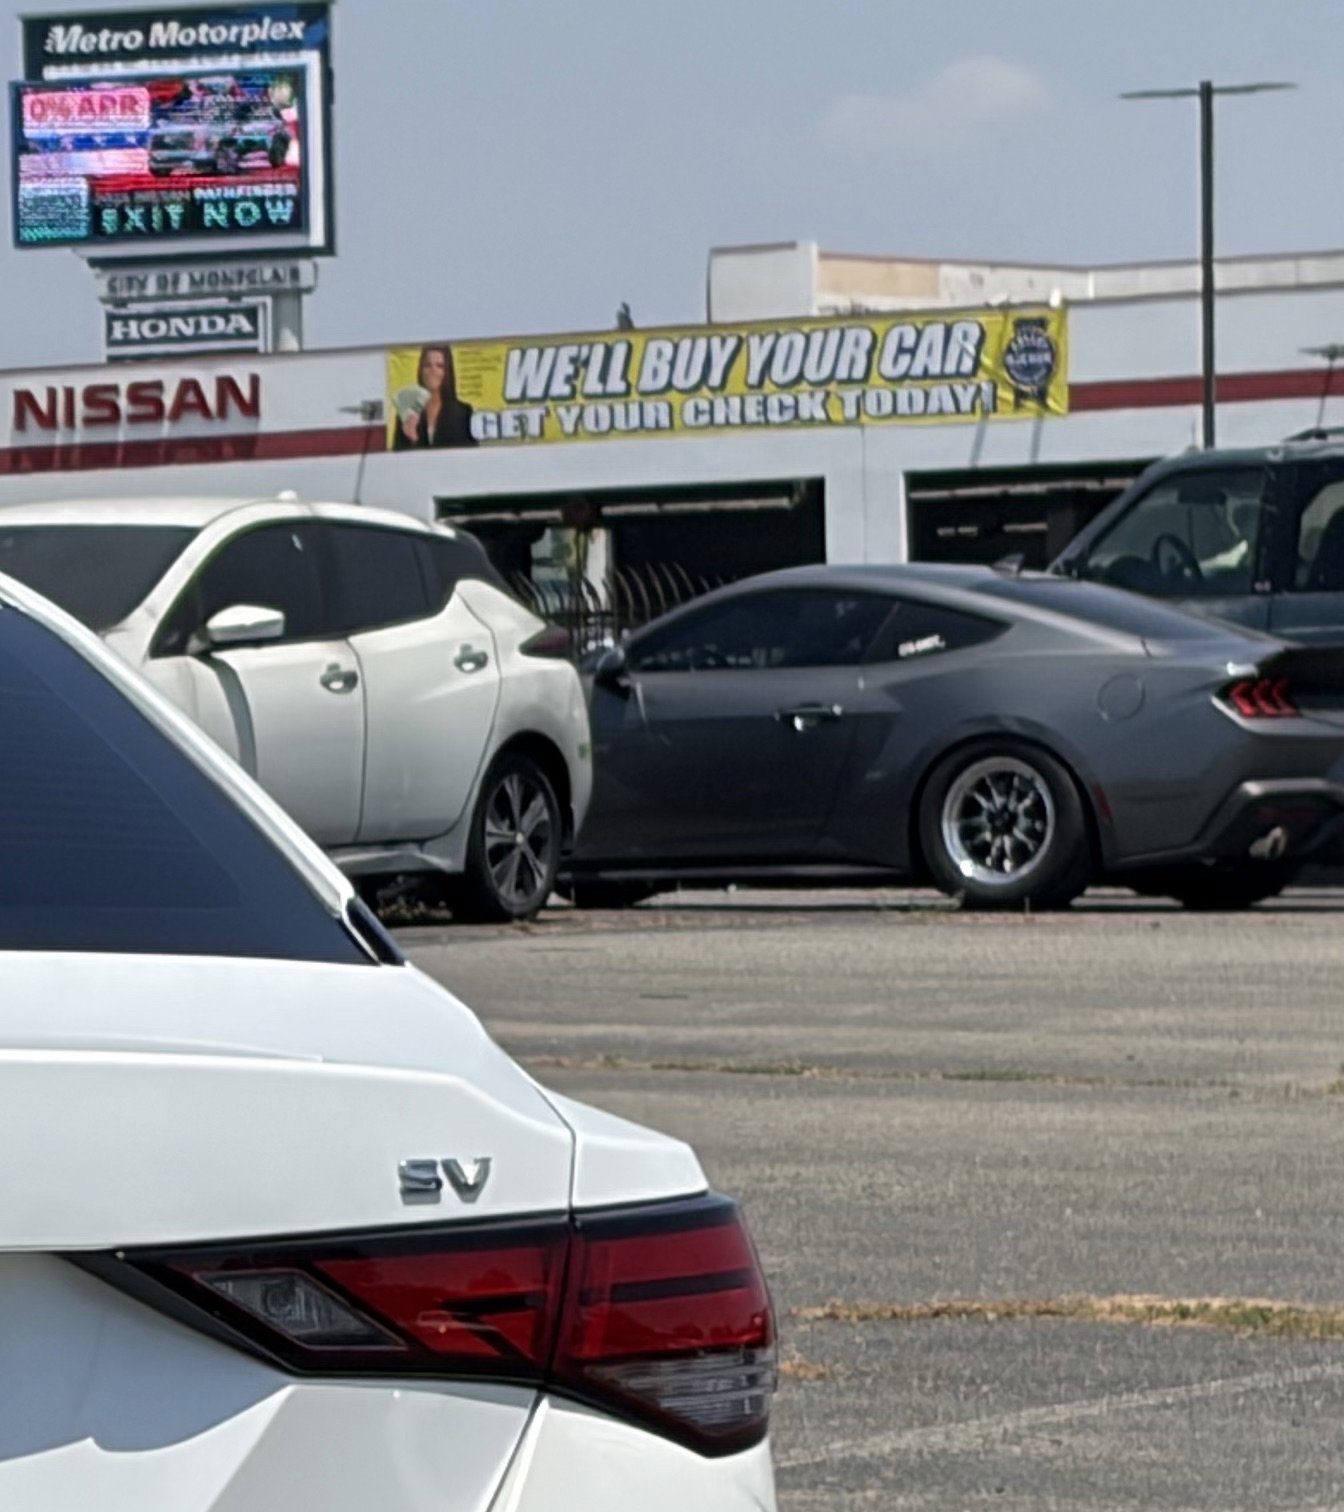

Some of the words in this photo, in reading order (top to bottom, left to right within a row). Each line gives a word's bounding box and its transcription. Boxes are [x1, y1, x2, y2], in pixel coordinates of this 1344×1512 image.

[44, 25, 144, 53] Metro
[149, 17, 306, 48] Motorplex
[203, 199, 295, 228] NOW
[110, 314, 255, 341] HONDA
[504, 339, 632, 403] WE'LL
[637, 334, 743, 396] BUY
[745, 326, 877, 390] YOUR
[878, 319, 986, 382] CAR
[13, 372, 262, 432] NISSAN
[469, 405, 548, 441] GET
[556, 401, 673, 434] YOUR
[682, 390, 830, 426] CHECK
[838, 380, 997, 421] TODAY!
[397, 1157, 493, 1206] SV
